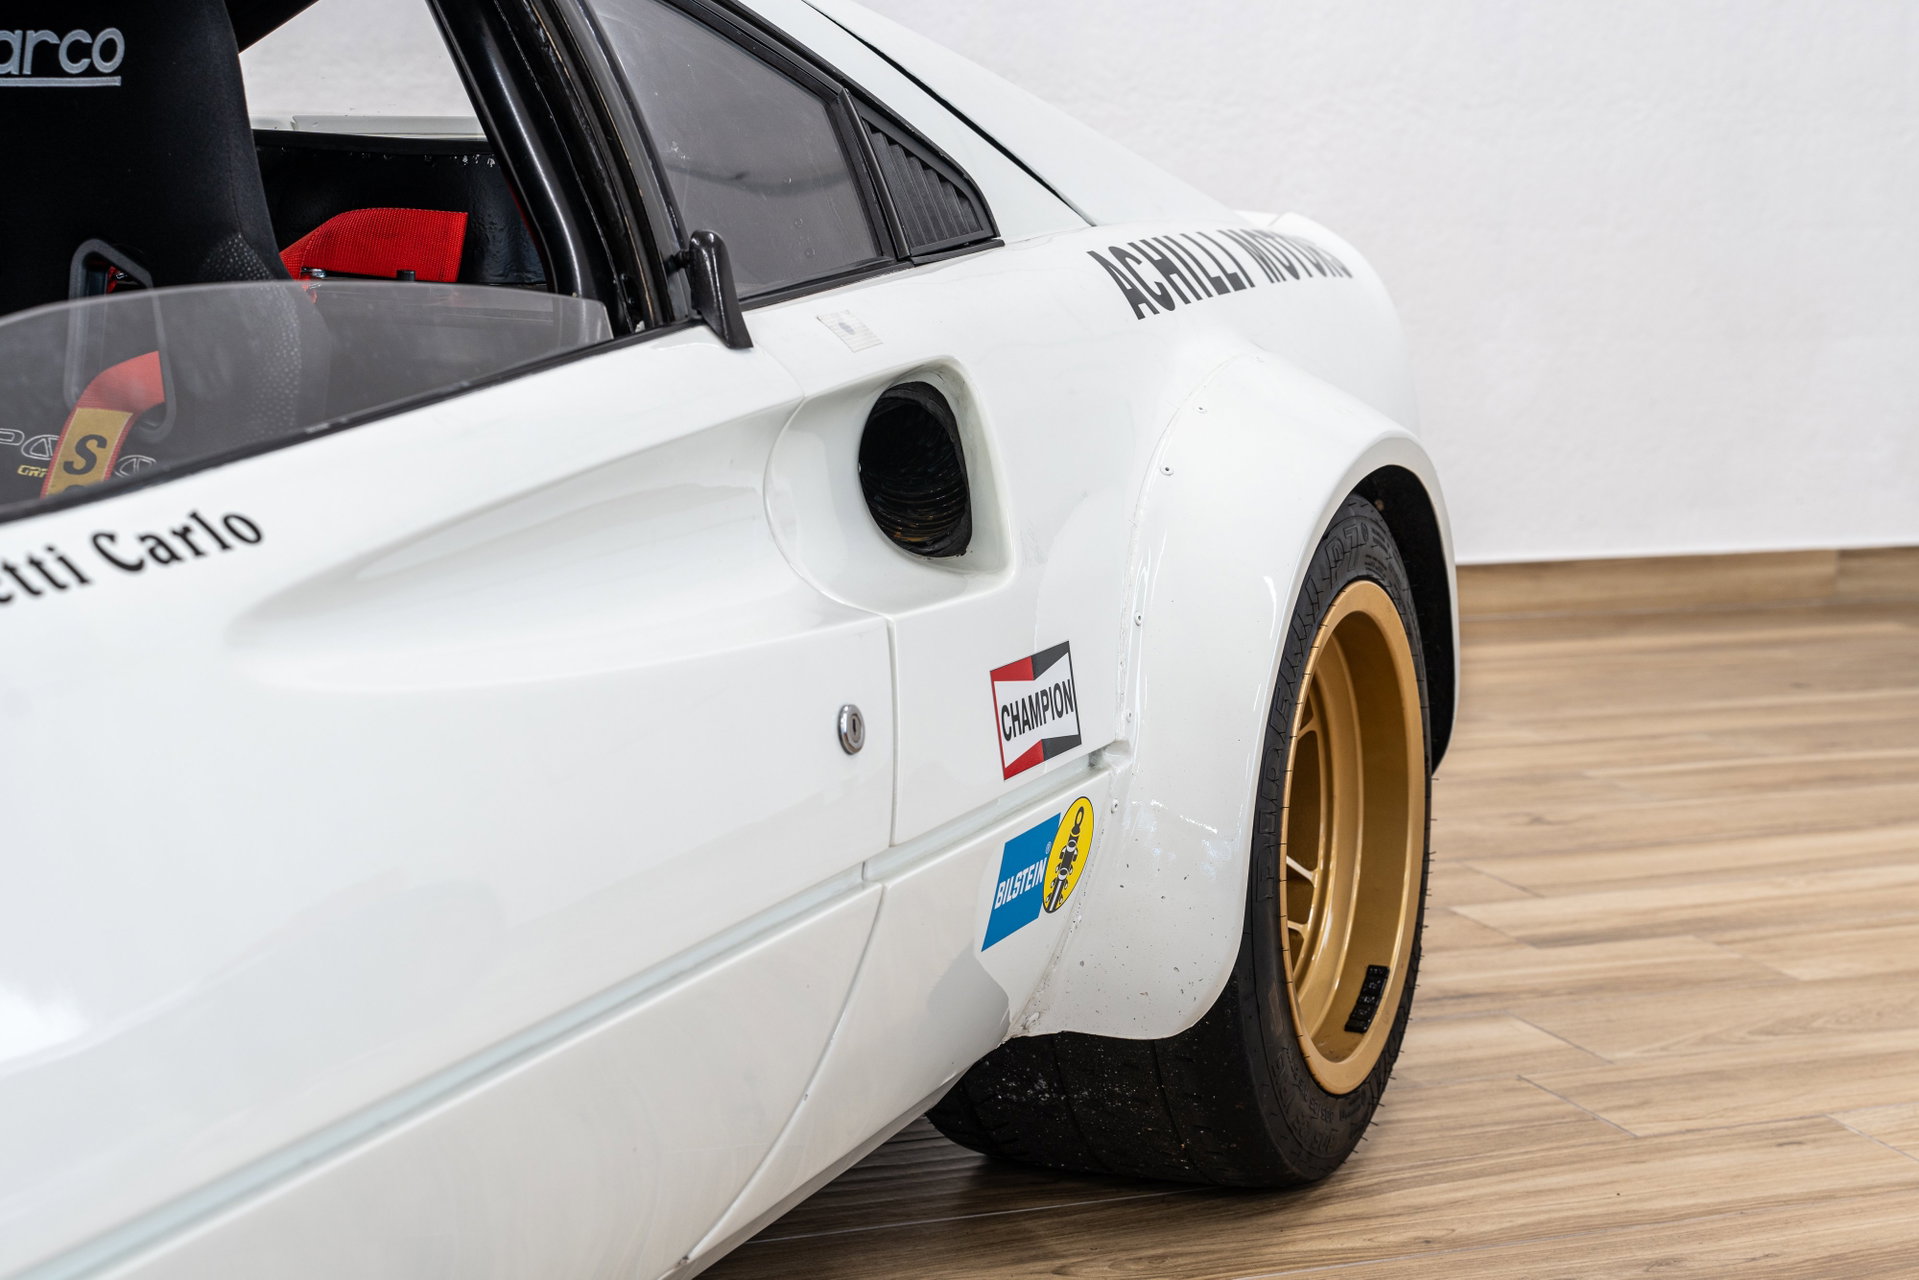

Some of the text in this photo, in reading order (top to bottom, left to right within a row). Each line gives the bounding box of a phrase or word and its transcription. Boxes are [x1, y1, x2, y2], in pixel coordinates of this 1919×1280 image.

[1086, 231, 1256, 321] ACHILLI
[91, 509, 263, 573] Carlo
[1001, 678, 1074, 742] CHAMPION
[994, 856, 1047, 910] BILSTEIN
